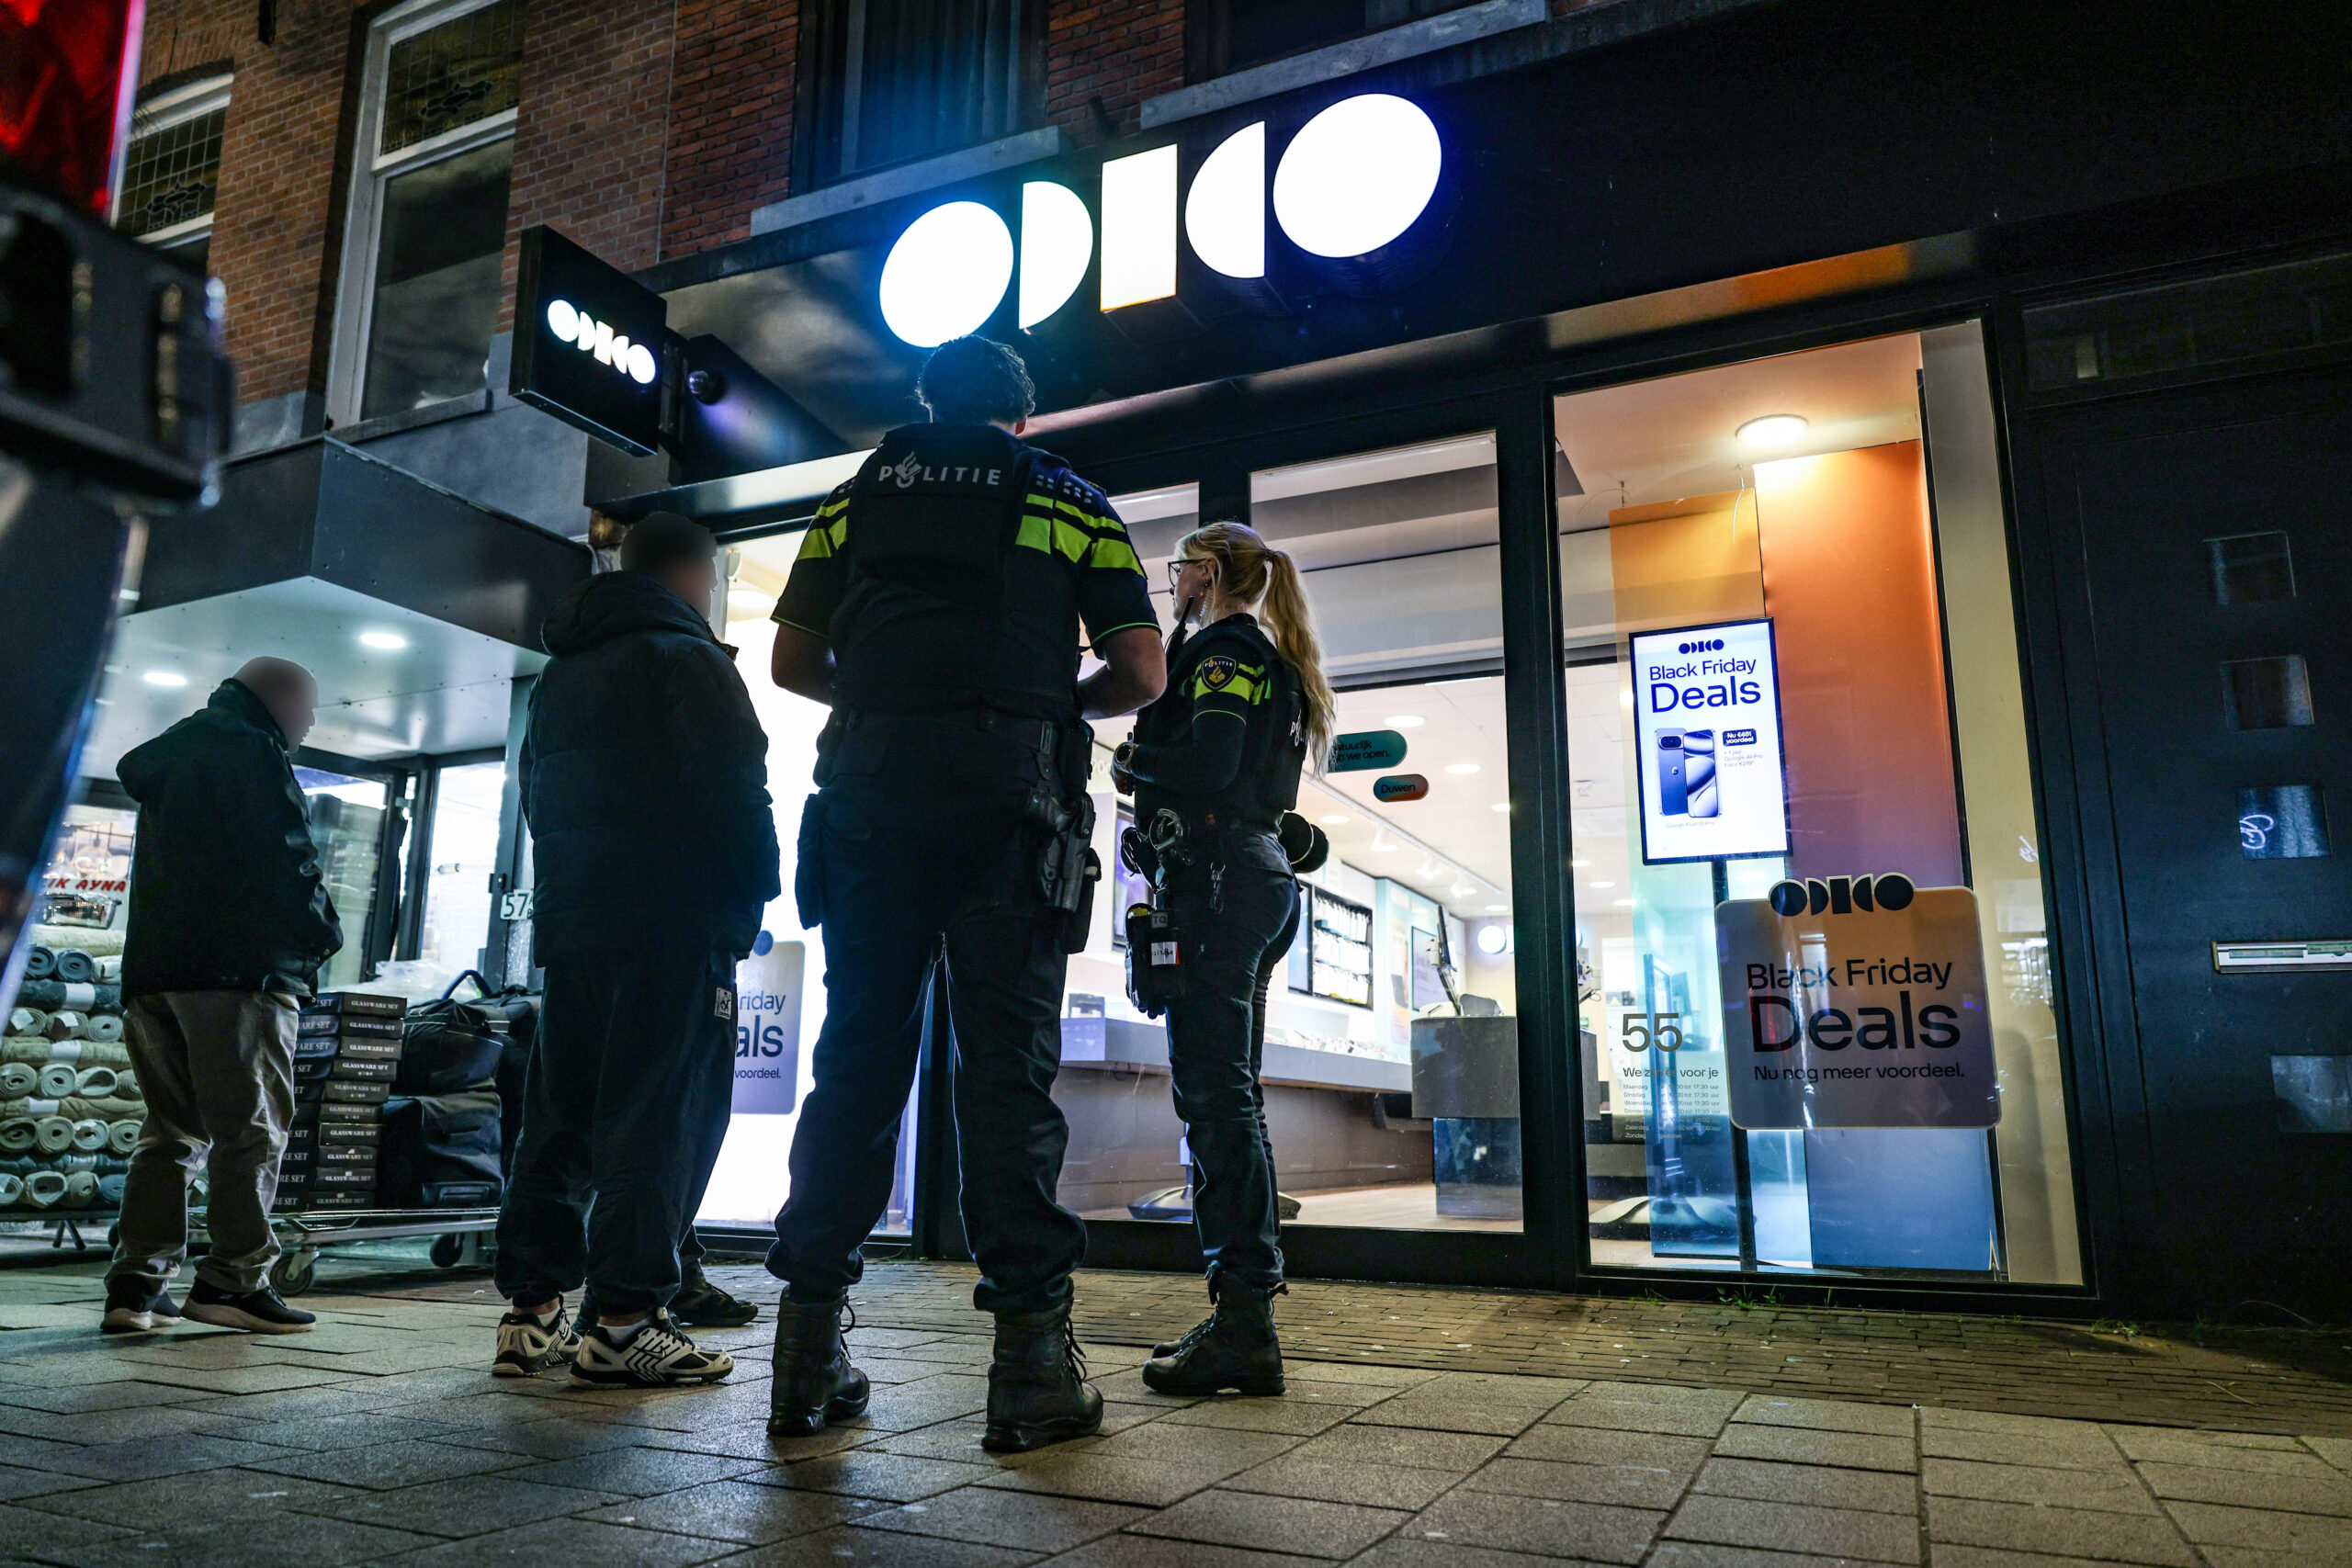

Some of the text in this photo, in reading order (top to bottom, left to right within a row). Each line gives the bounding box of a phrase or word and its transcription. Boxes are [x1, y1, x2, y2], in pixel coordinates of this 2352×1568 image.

[878, 458, 1001, 488] POLITIE
[1650, 658, 1757, 681] Black Friday
[1651, 675, 1761, 713] Deals
[1363, 750, 1390, 761] open.
[1381, 784, 1416, 795] Duwen
[76, 880, 127, 892] AYNA
[1747, 957, 1953, 990] Black Friday
[351, 1000, 387, 1009] GLASSWARE
[349, 1021, 383, 1030] GLASSWARE
[1749, 990, 1961, 1053] Deals
[1623, 1012, 1683, 1053] 55
[315, 1042, 331, 1050] SET
[1623, 1067, 1642, 1077] We
[1680, 1069, 1706, 1077] voor
[1708, 1067, 1719, 1079] je
[1754, 1062, 1965, 1083] Nu nog meer voordeel.
[294, 1152, 309, 1160] SET
